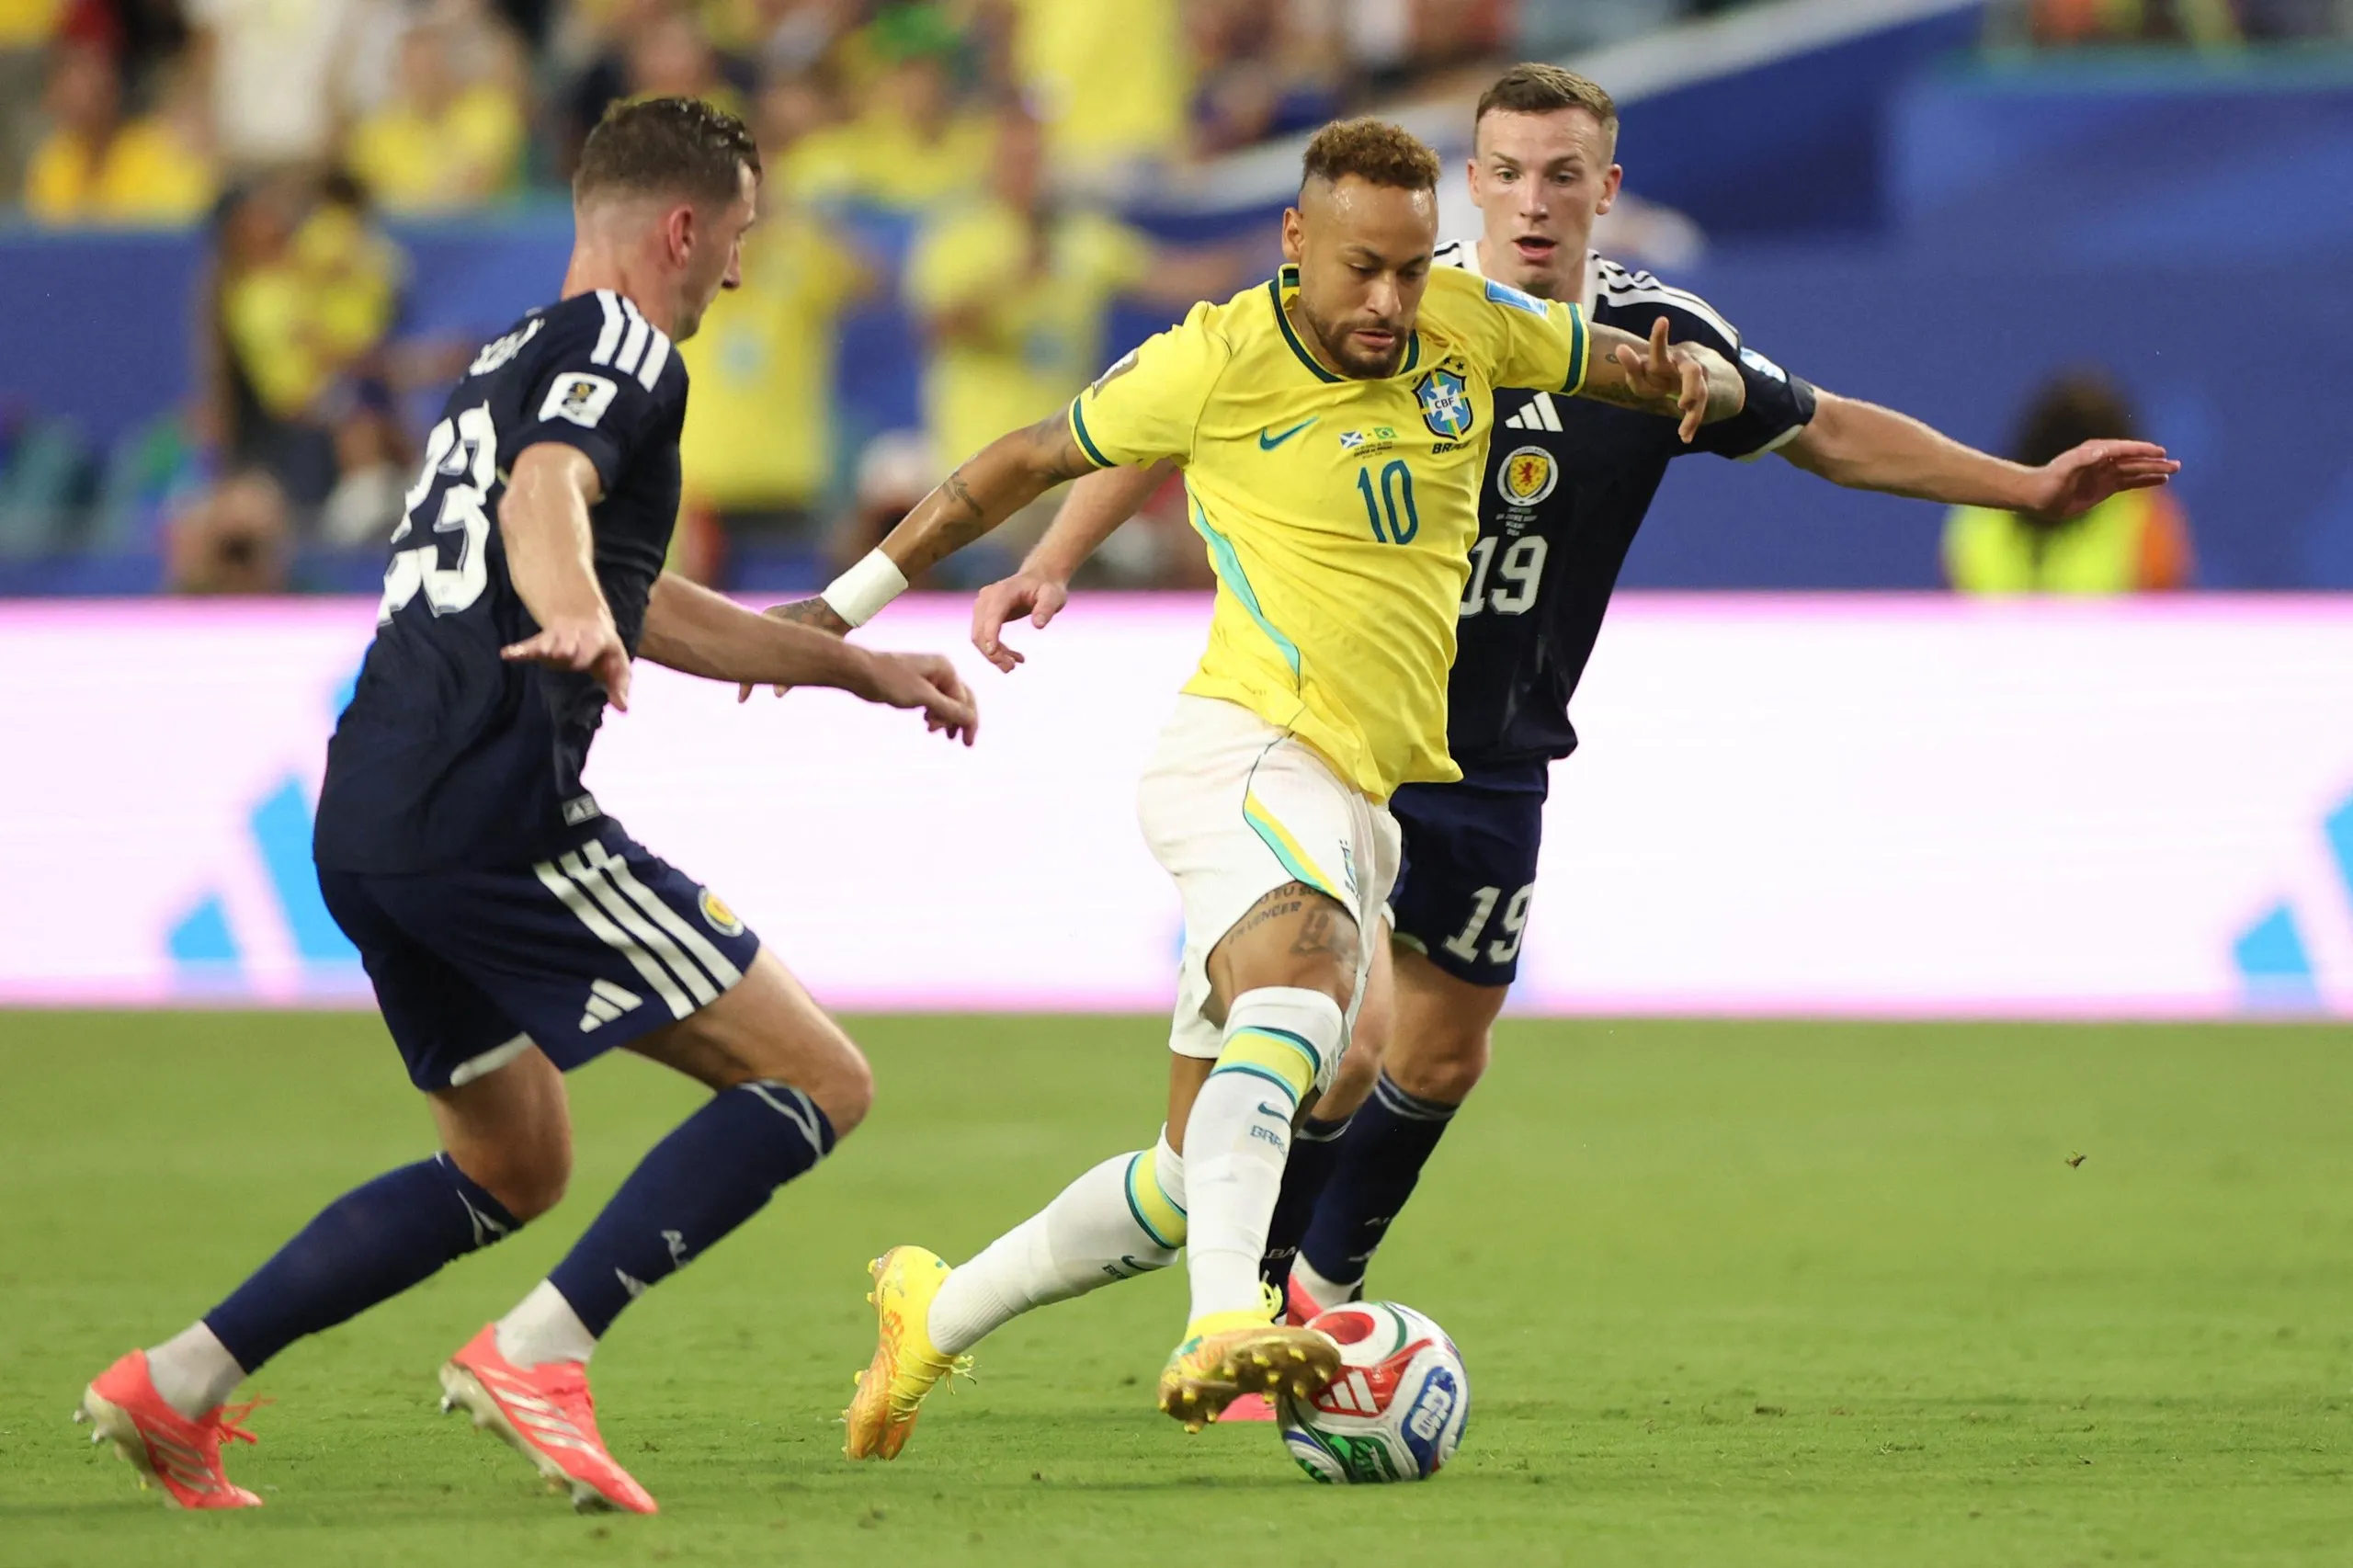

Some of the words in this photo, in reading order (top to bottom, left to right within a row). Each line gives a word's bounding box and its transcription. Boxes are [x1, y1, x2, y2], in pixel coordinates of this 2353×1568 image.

[1434, 396, 1455, 410] CBF
[375, 399, 497, 618] 23
[1358, 460, 1418, 545] 10
[1460, 536, 1548, 618] 19
[1442, 881, 1534, 964] 19
